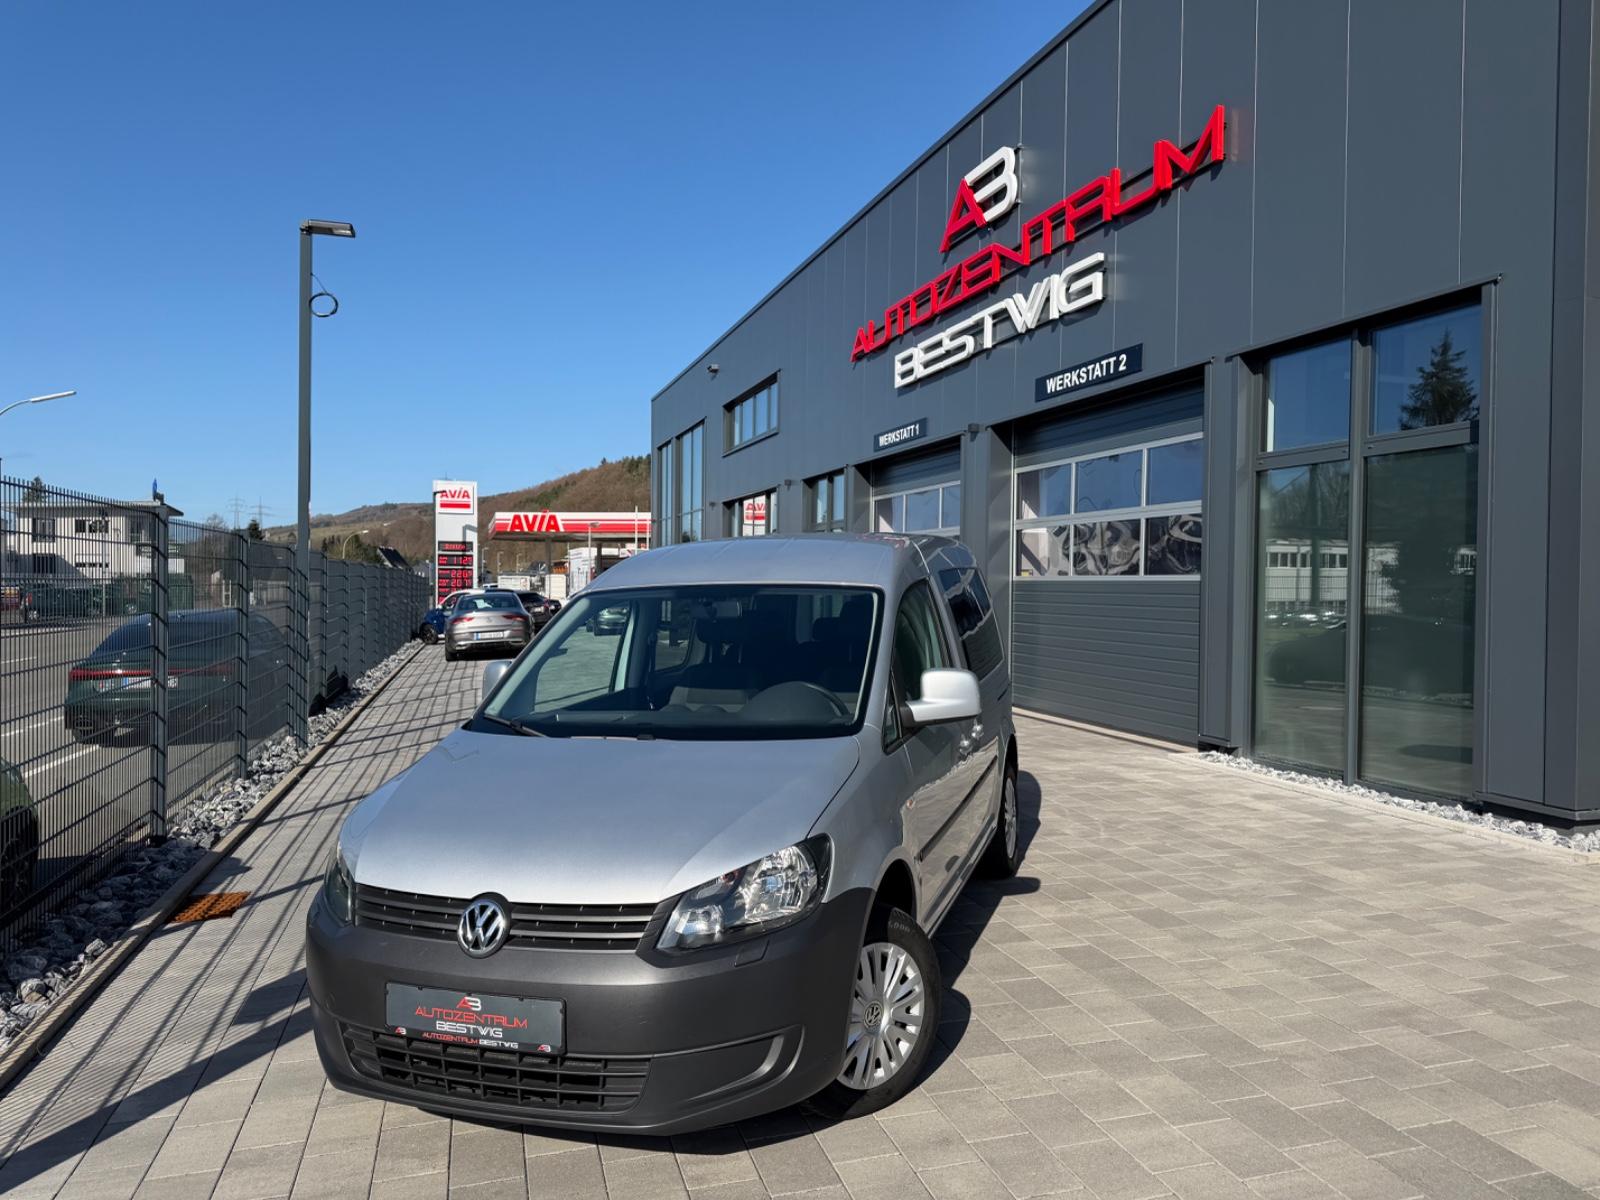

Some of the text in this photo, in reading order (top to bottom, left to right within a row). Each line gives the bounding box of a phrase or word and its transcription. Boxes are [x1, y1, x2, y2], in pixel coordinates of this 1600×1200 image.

[850, 104, 1225, 362] AUTOZENTRUM
[894, 252, 1105, 389] BESTWIG
[1046, 353, 1127, 394] WERKSTATT 2
[879, 424, 915, 447] WERKSTATT
[415, 1006, 528, 1029] AUTOZENTRUM
[422, 1032, 519, 1049] AUTOZENTRUM BESTWIG
[436, 1020, 503, 1039] BESTWIG
